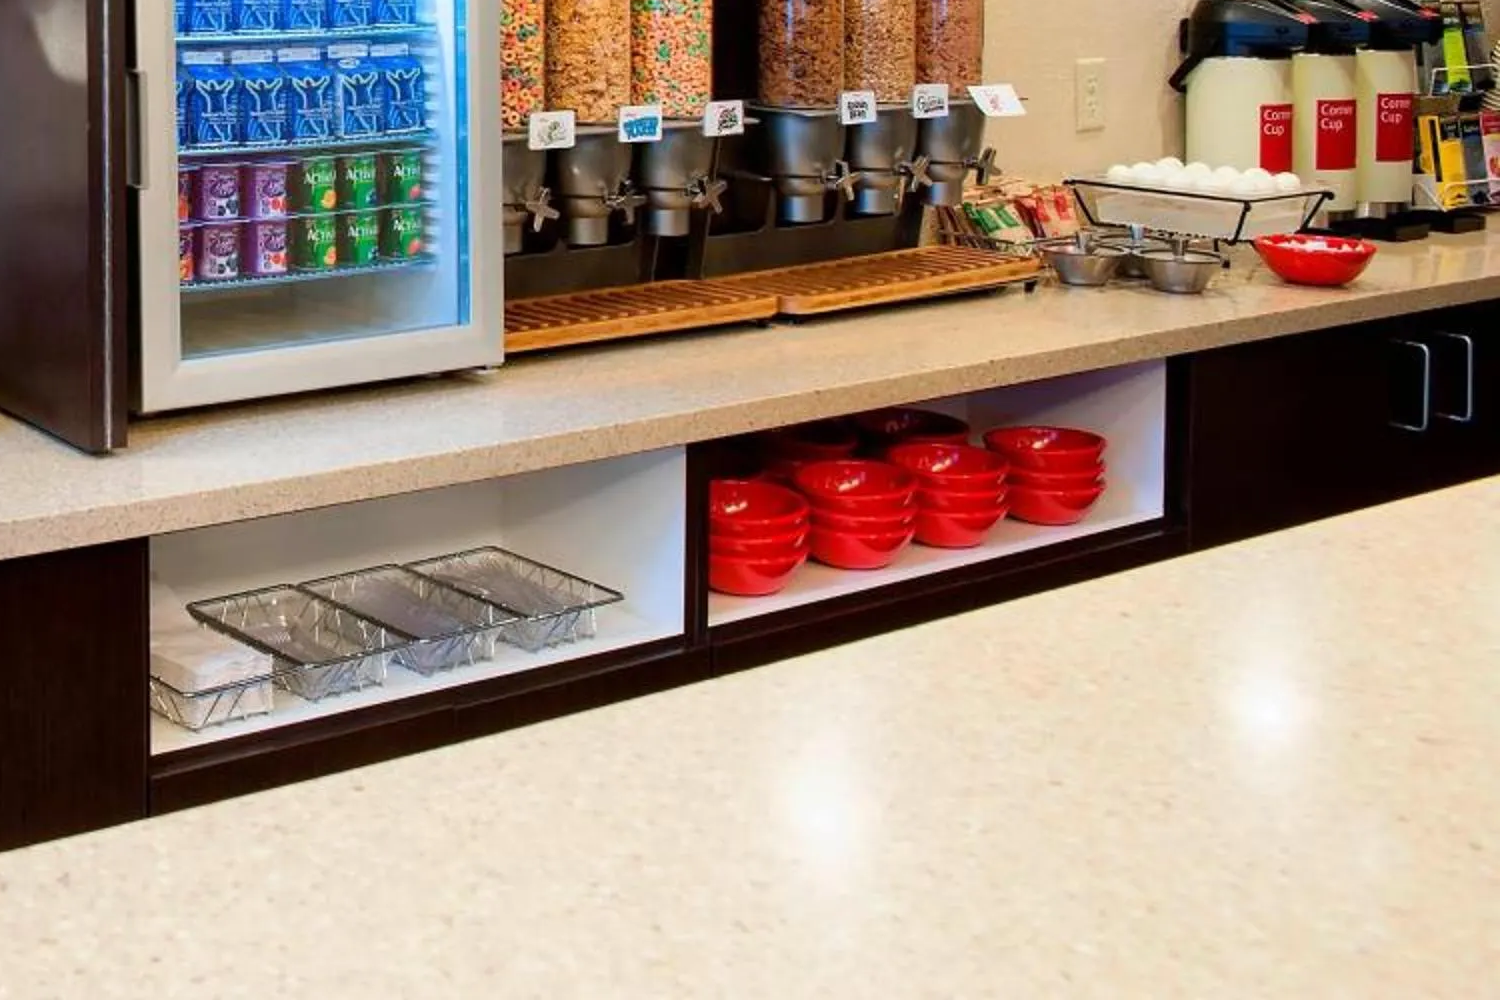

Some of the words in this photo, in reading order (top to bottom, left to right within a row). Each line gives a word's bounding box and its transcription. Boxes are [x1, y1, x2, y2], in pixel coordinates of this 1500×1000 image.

[1380, 111, 1403, 124] Cup
[1263, 124, 1285, 136] Cup
[1320, 118, 1343, 133] Cup
